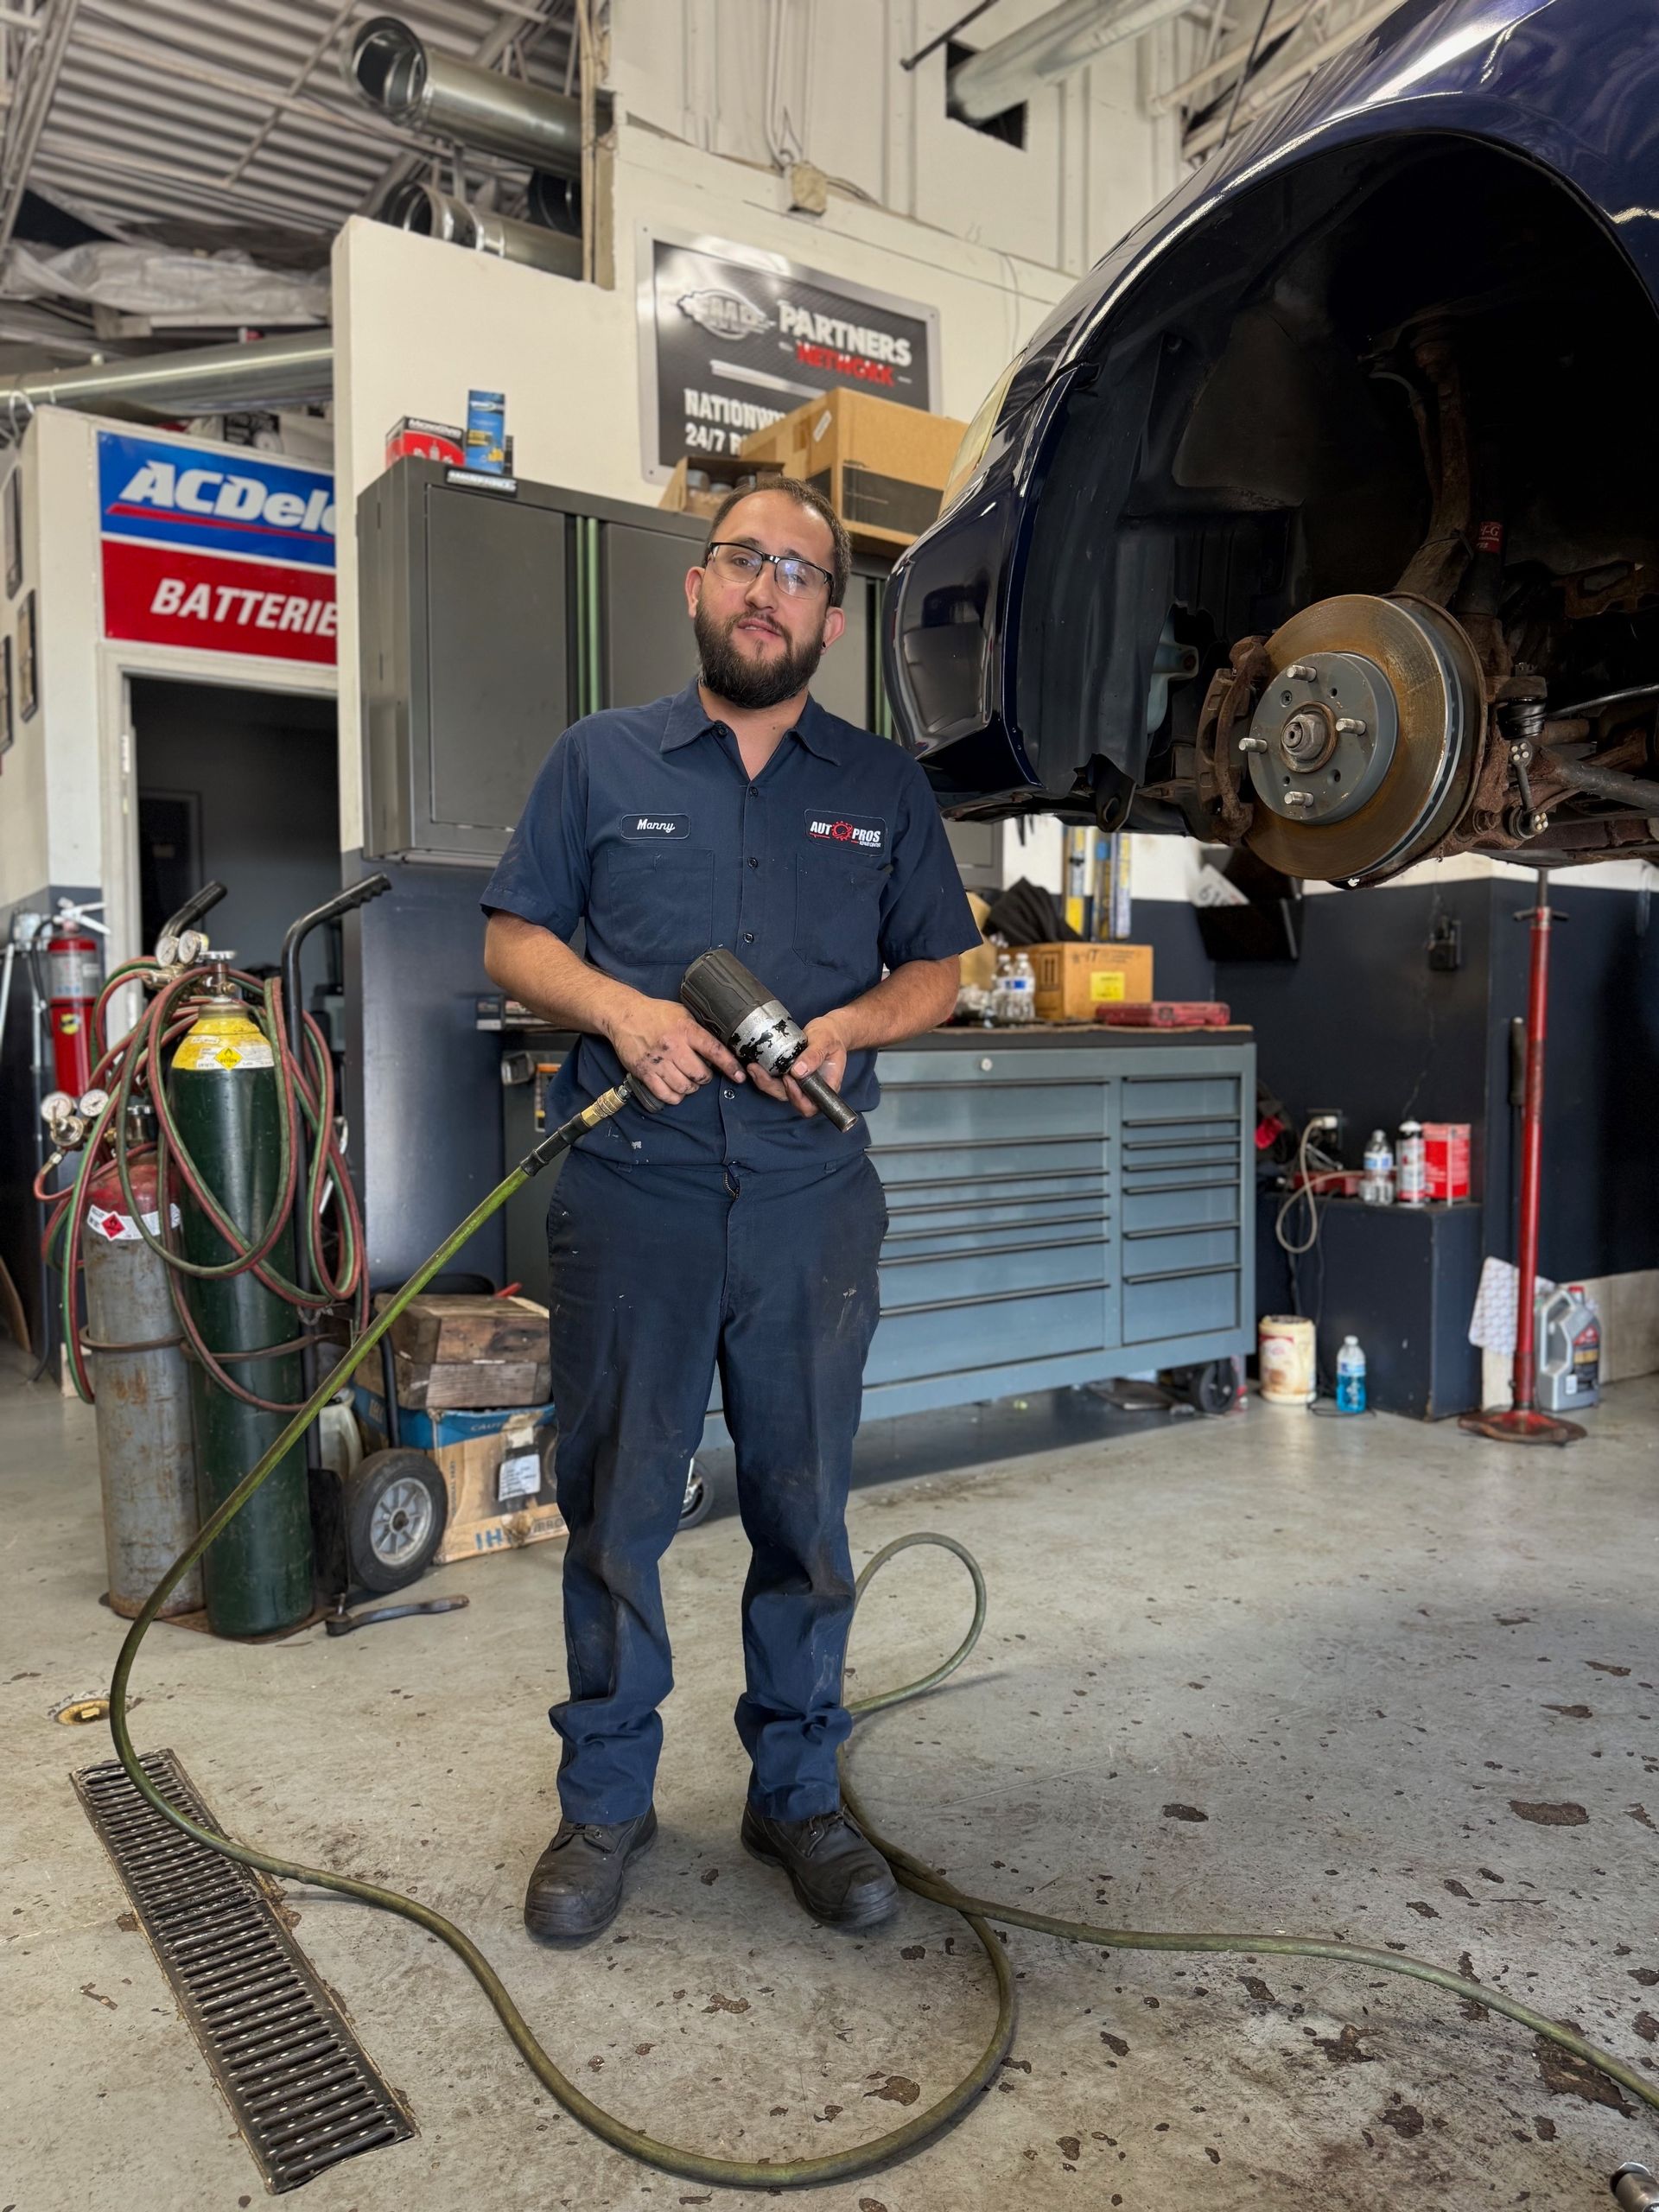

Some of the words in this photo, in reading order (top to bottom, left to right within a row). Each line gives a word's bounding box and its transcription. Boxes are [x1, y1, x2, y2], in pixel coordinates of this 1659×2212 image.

[778, 302, 912, 366] PARTNERS
[796, 340, 894, 386] NETWORK
[684, 388, 786, 431] NATIONW
[685, 422, 726, 453] 24/7
[118, 460, 335, 534] ACDel
[149, 577, 336, 637] BATTERIE
[636, 818, 676, 834] Manny
[851, 827, 881, 842] PROS
